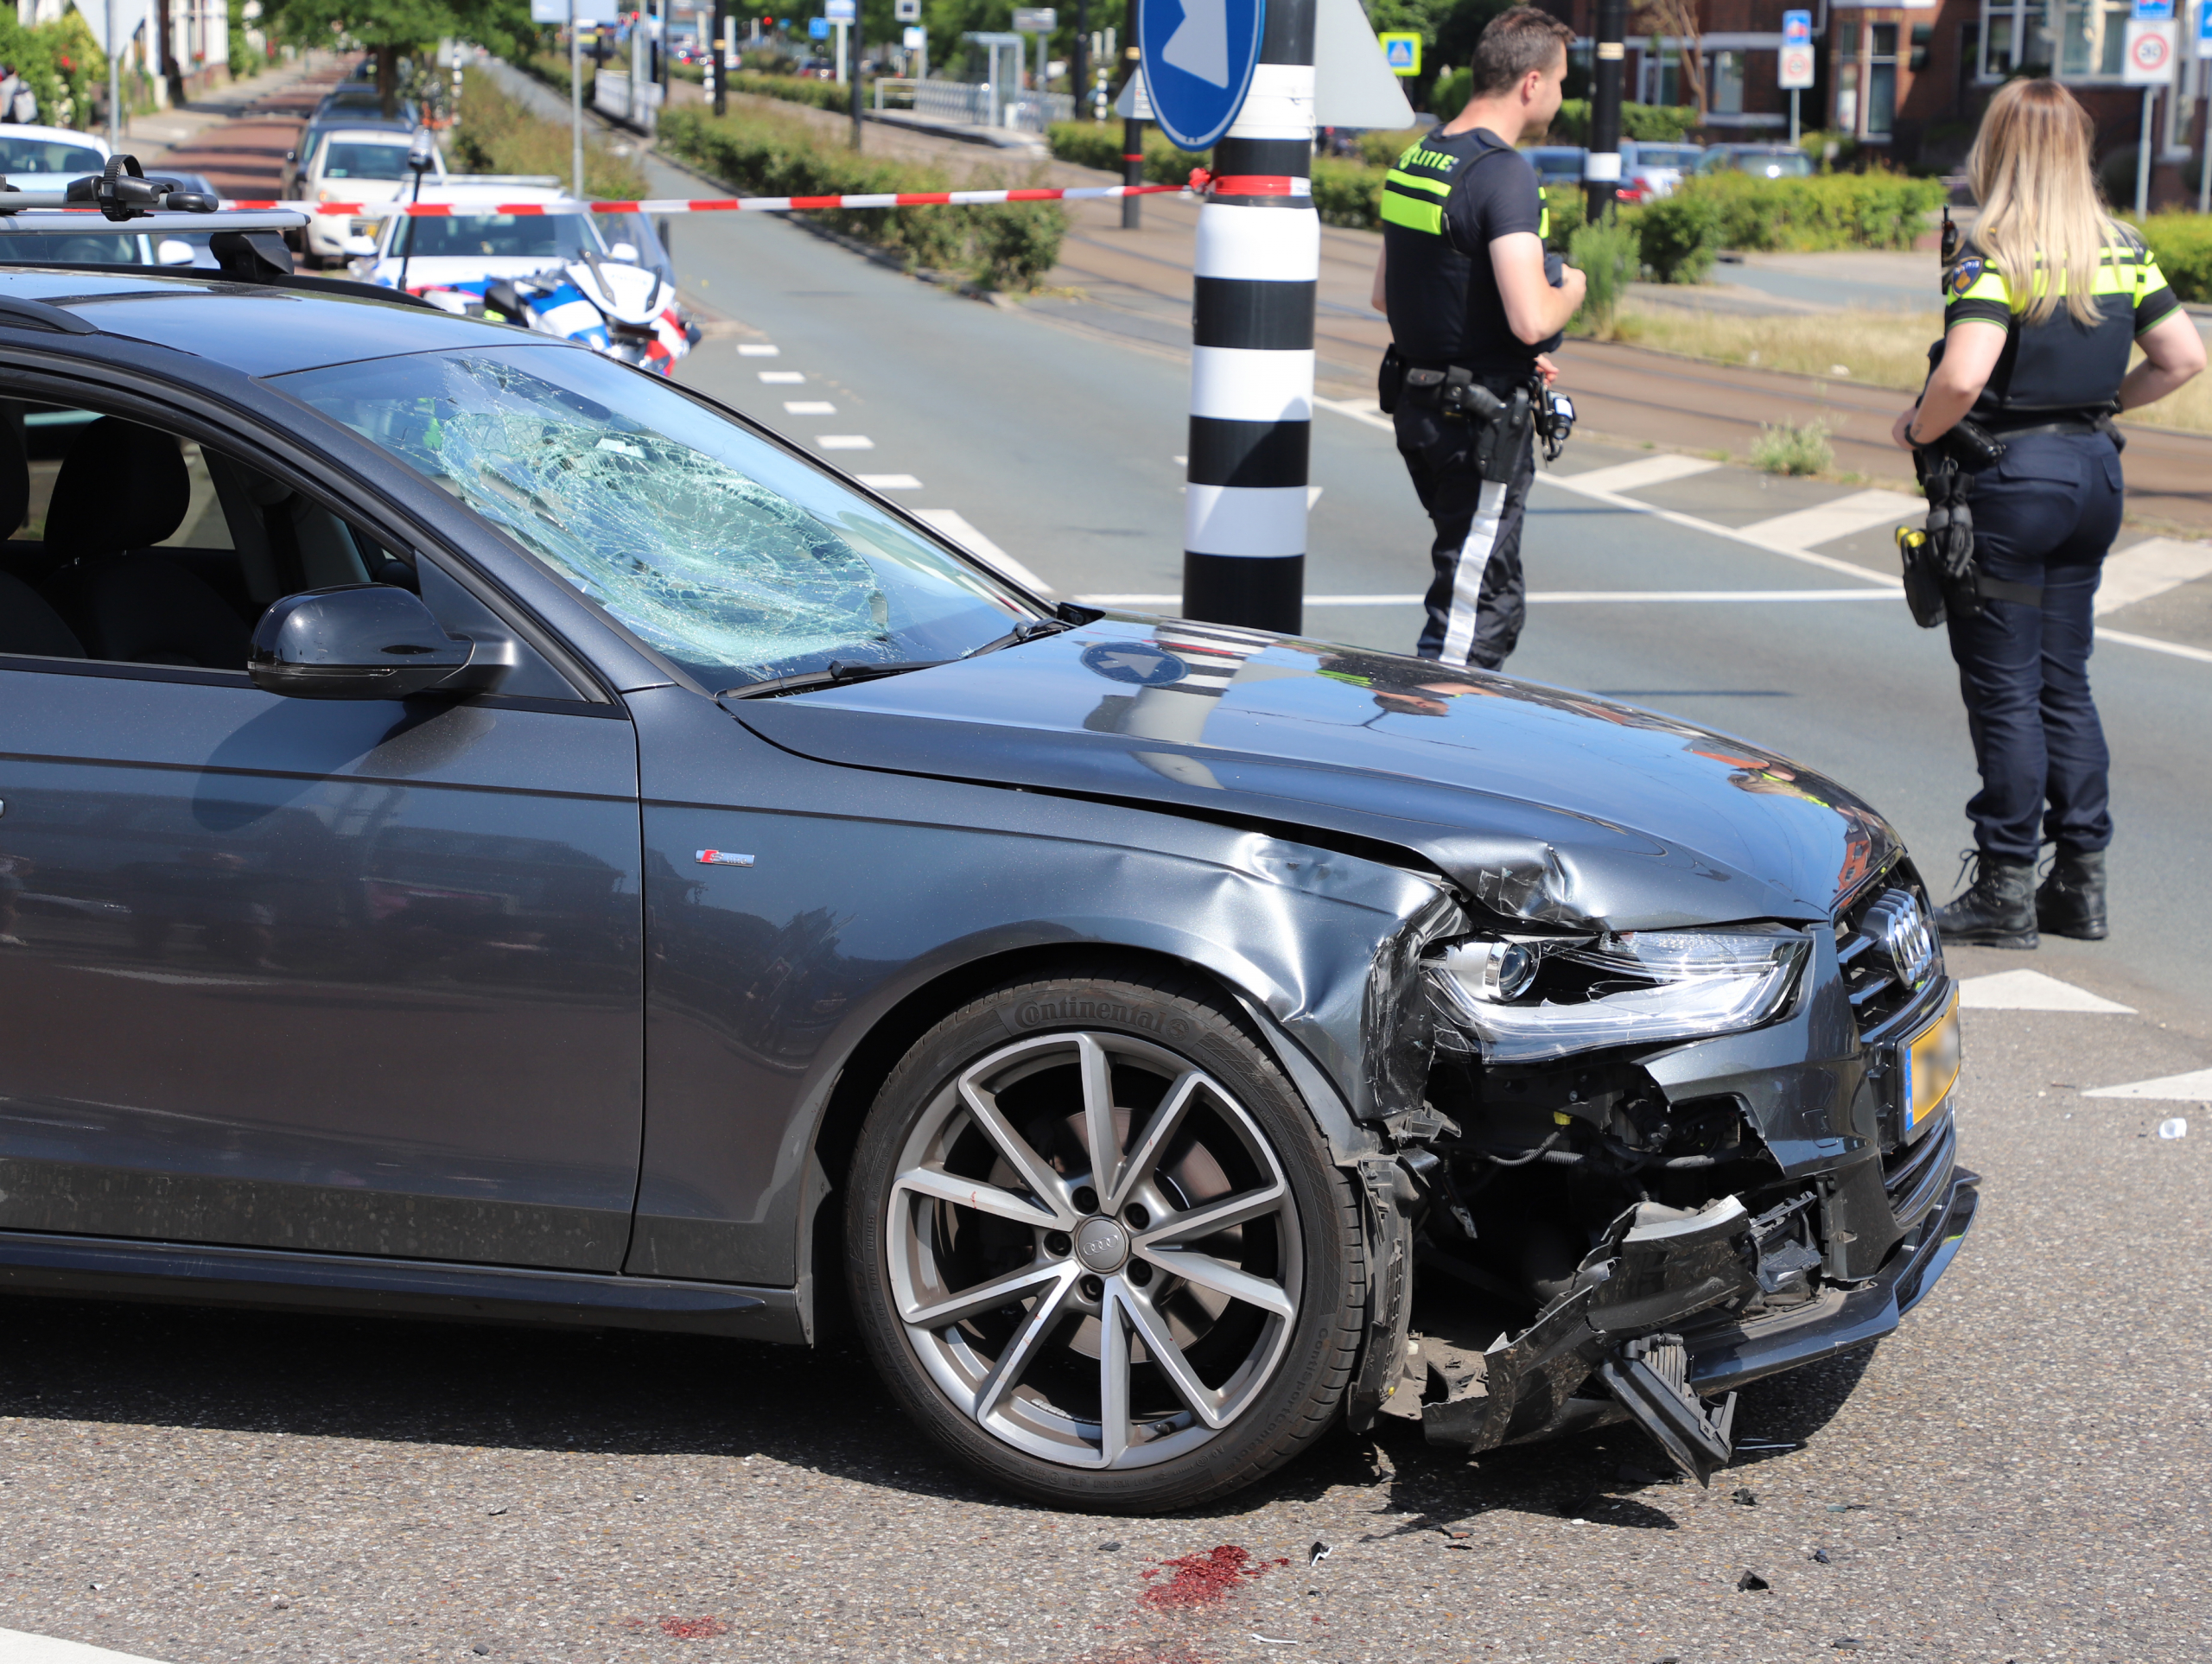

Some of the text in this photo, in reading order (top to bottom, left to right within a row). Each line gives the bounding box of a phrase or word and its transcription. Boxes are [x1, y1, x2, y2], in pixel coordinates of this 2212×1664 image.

[709, 853, 747, 865] S line
[1014, 996, 1166, 1034] Continental
[855, 1271, 923, 1413] 255/35 ZR 19
[1231, 1326, 1329, 1466] ContiSportContact
